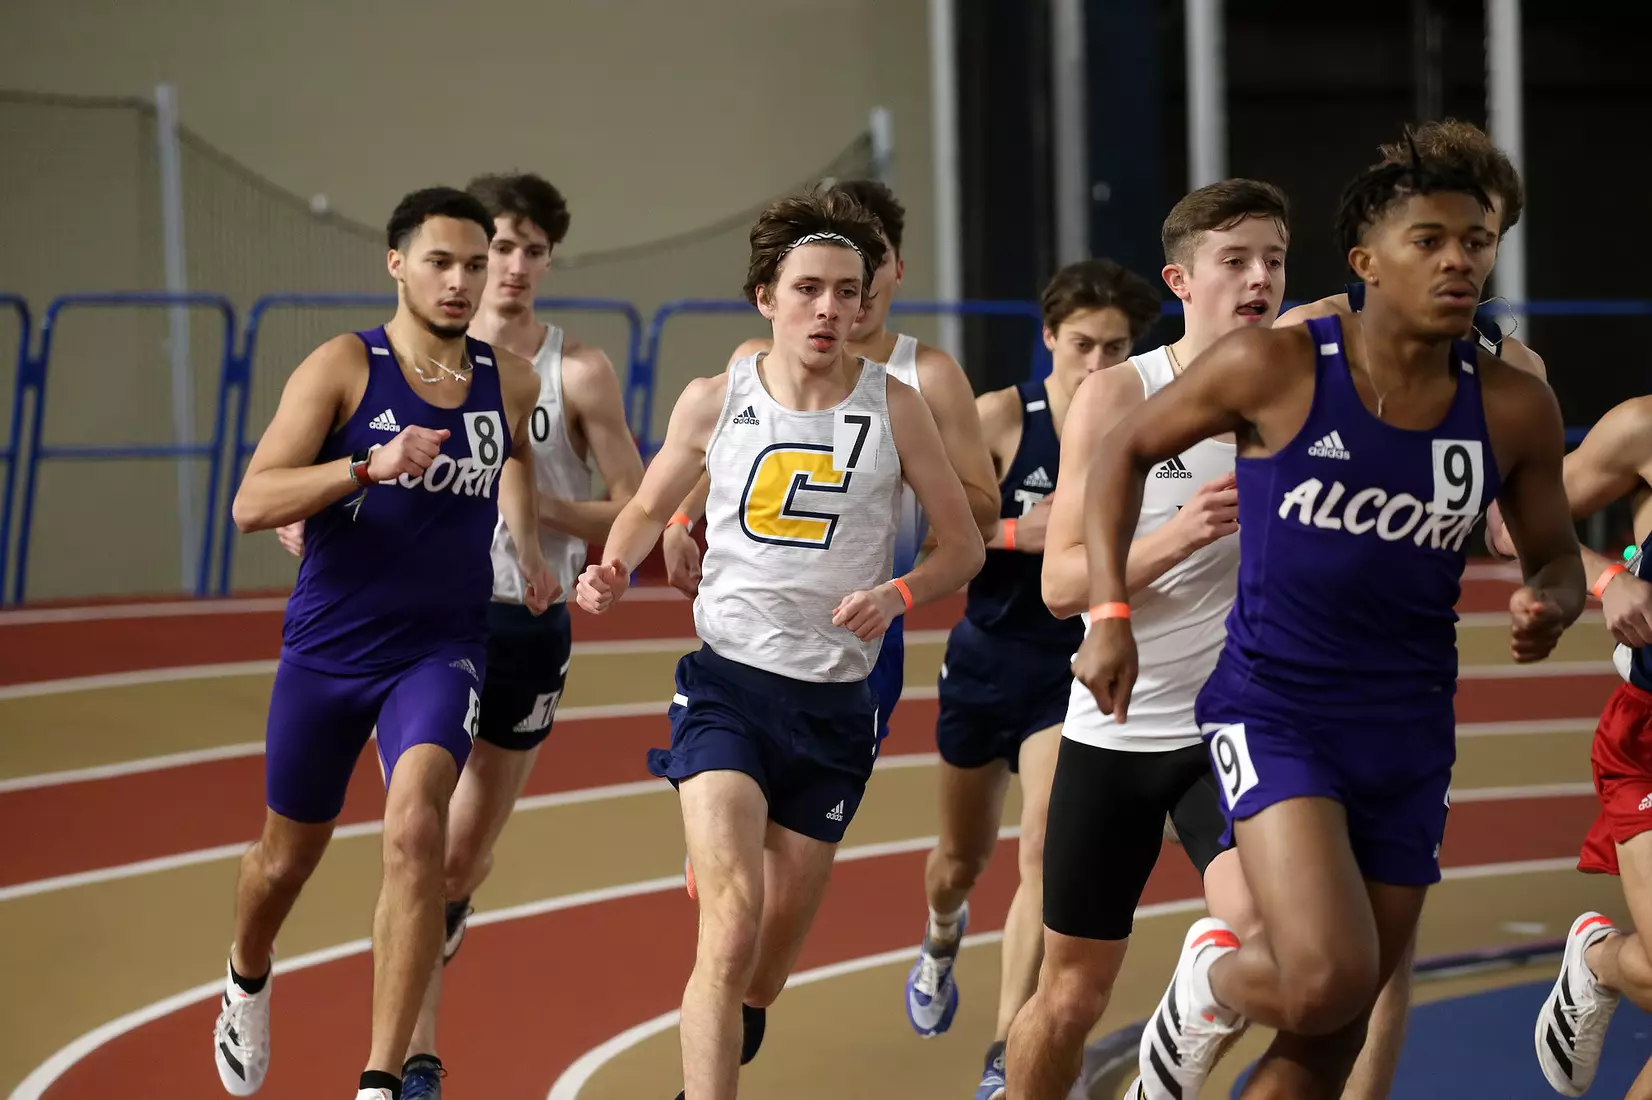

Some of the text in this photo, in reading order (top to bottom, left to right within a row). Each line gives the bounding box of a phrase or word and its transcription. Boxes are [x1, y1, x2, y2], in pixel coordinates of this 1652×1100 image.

[369, 421, 400, 432] adidas
[474, 415, 499, 466] 8
[844, 414, 871, 468] 7
[1155, 469, 1192, 479] adidas
[1308, 446, 1350, 461] adidas
[1443, 444, 1474, 512] 9
[739, 442, 852, 551] C
[1216, 734, 1242, 797] 9
